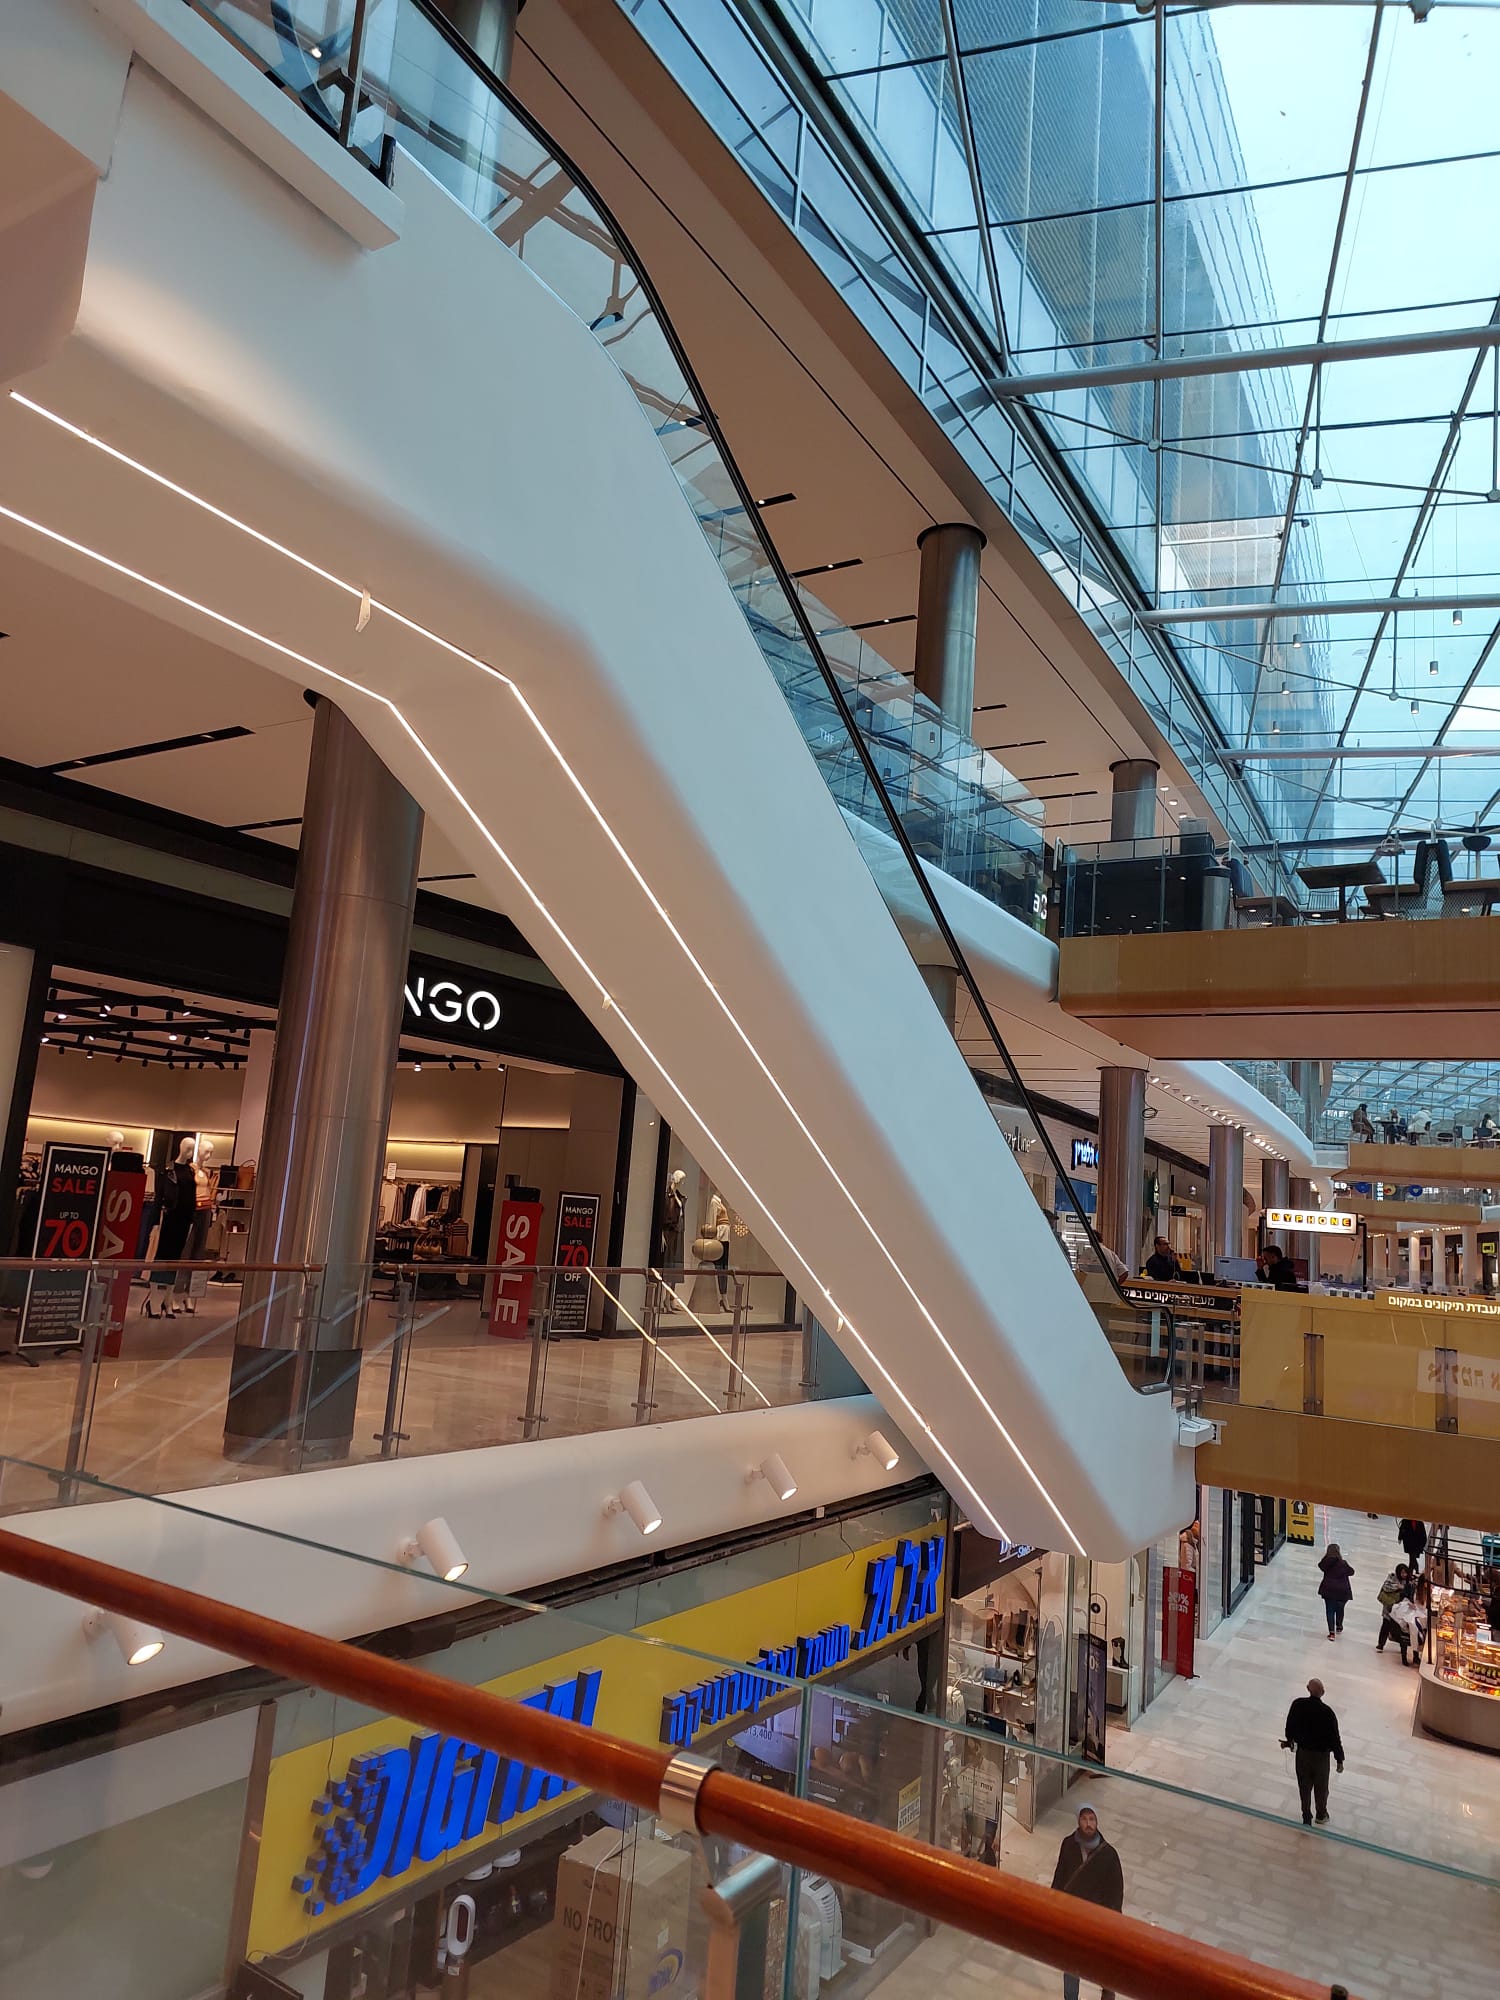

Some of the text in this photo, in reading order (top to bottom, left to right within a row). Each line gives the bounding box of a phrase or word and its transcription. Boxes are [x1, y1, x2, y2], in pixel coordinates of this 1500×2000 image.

[404, 977, 501, 1031] NGO
[54, 1163, 99, 1176] MANGO
[51, 1177, 97, 1195] SALE
[59, 1211, 79, 1220] UP TO
[565, 1206, 594, 1215] MANGO
[563, 1216, 593, 1229] SALE
[1271, 1213, 1352, 1227] MYPHONE
[494, 1214, 531, 1324] SALE
[564, 1273, 582, 1283] OFF
[1388, 1296, 1423, 1308] במקום
[1424, 1299, 1465, 1312] תיקונים
[796, 1622, 850, 1680] חשמל
[563, 1906, 582, 1931] NO
